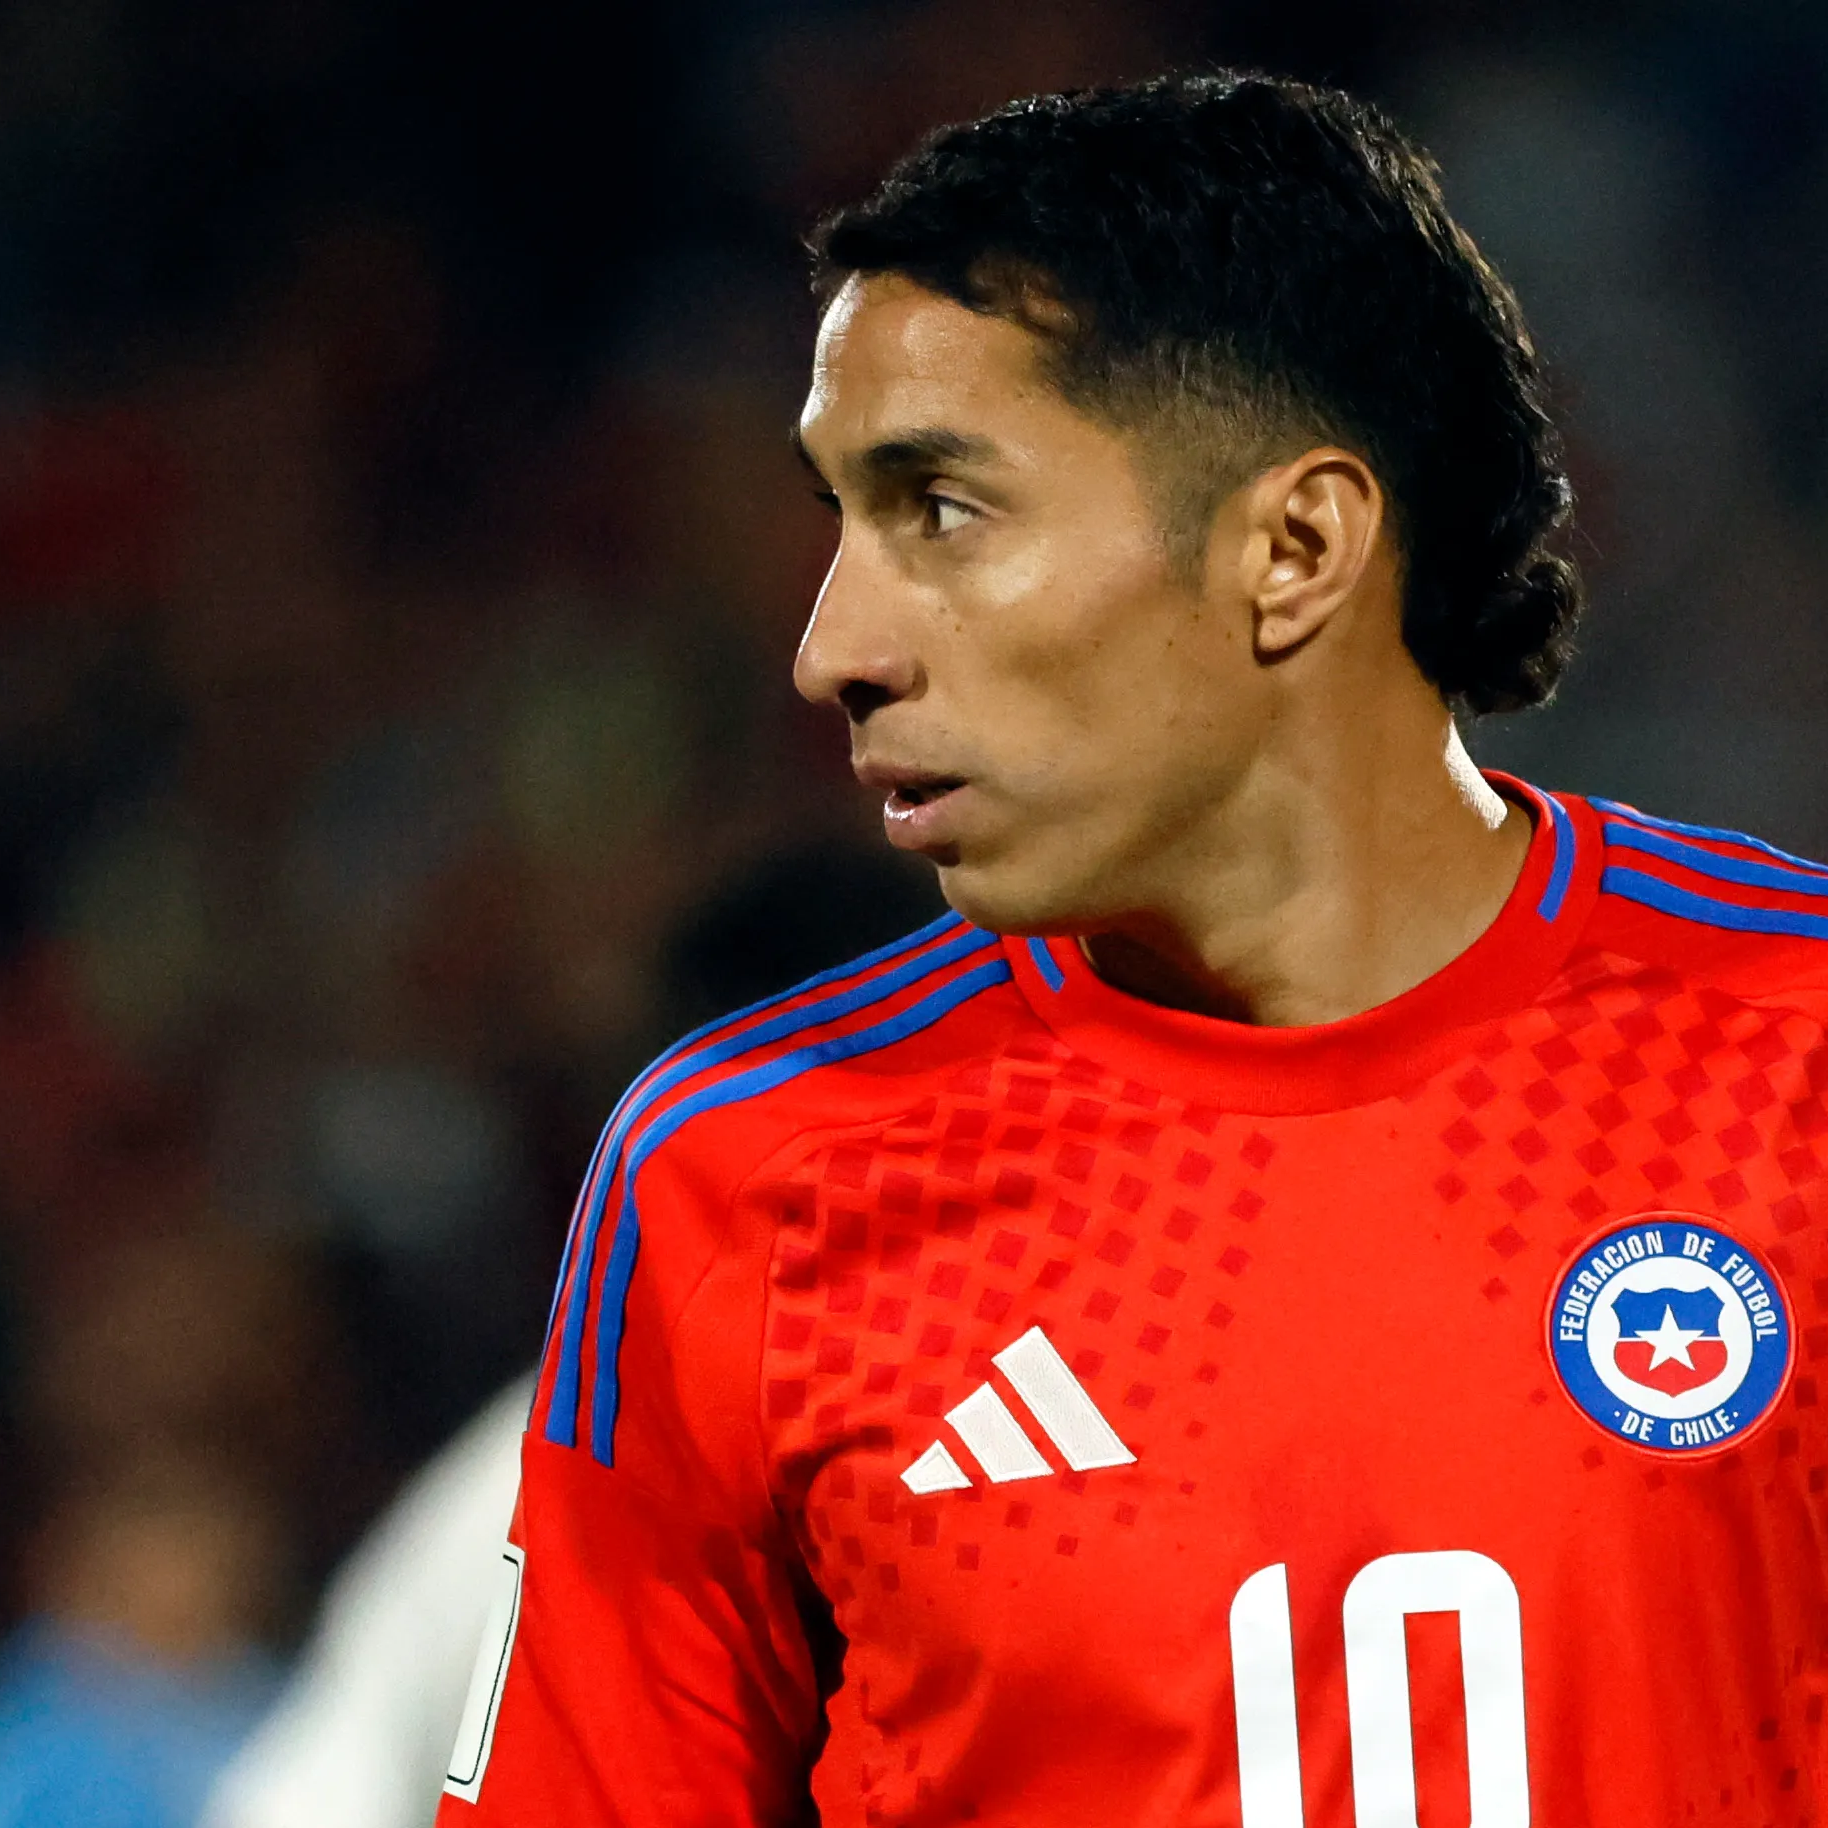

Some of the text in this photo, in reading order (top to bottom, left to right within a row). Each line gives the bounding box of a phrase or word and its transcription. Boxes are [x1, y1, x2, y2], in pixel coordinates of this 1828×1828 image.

[1560, 1230, 1778, 1342] FEDERACION DE FUTBOL
[1621, 1409, 1735, 1446] DE CHILE
